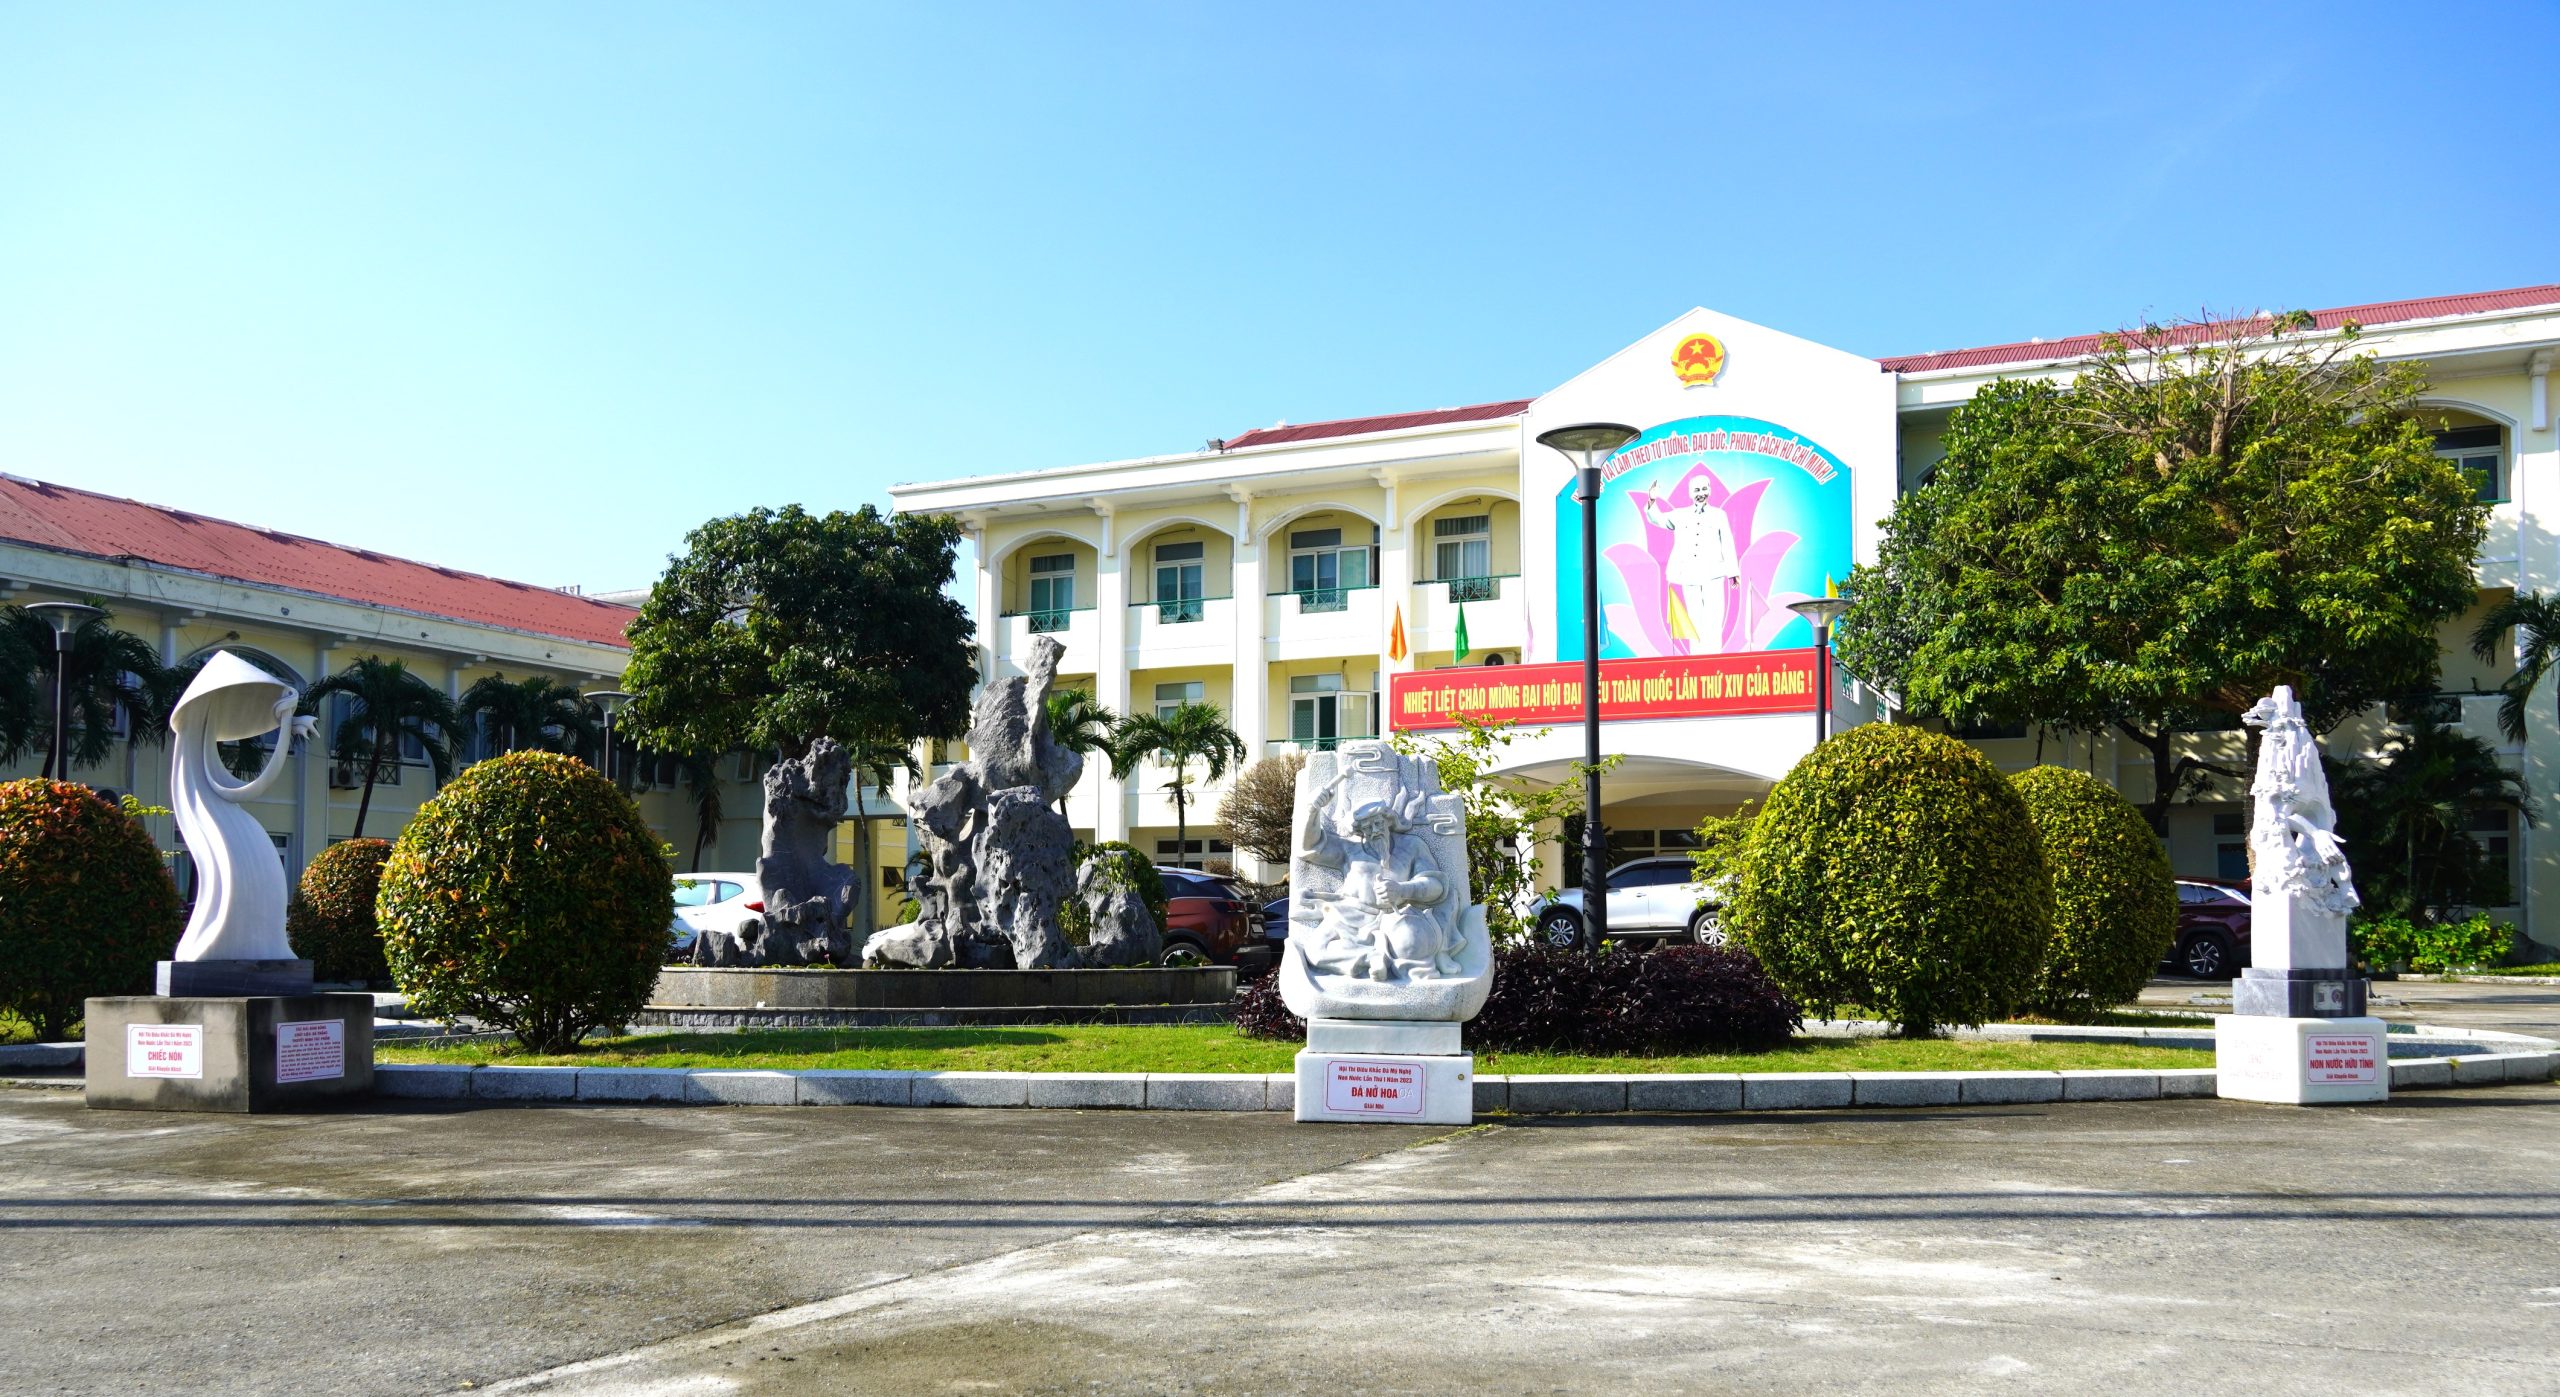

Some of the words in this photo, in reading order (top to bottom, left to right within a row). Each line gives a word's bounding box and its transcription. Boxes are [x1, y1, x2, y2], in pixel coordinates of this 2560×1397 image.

[1612, 453, 1632, 474] LÀM
[1630, 445, 1651, 467] THEO
[1693, 432, 1709, 455] ĐẠO
[1710, 430, 1728, 451] ĐỨC,
[1730, 432, 1758, 452] PHONG
[1758, 433, 1780, 456] CÁCH
[1791, 445, 1812, 465] CHÍ
[1403, 686, 1433, 718] NHIỆT
[1435, 685, 1457, 716] LIỆT
[1458, 683, 1486, 711] CHÀO
[1488, 681, 1520, 709] MỪNG
[1522, 682, 1541, 712] ĐẠI
[1543, 679, 1561, 711] HỘI
[1563, 682, 1582, 710] ĐẠI
[1611, 674, 1641, 703] TOÀN
[1643, 669, 1673, 704] QUỐC
[1675, 669, 1698, 701] LẦN
[1700, 669, 1723, 699] THỨ
[1725, 673, 1744, 698] XIV
[1746, 665, 1770, 697] CỦA
[1772, 663, 1805, 696] ĐẢNG
[147, 1048, 167, 1061] CHIẾC
[2310, 1059, 2324, 1069] NON
[2325, 1057, 2343, 1069] NƯỚC
[2345, 1057, 2358, 1069] HỮU
[1351, 1085, 1363, 1097] ĐÁ
[1366, 1084, 1379, 1098] NỞ
[1380, 1088, 1398, 1099] HOA
